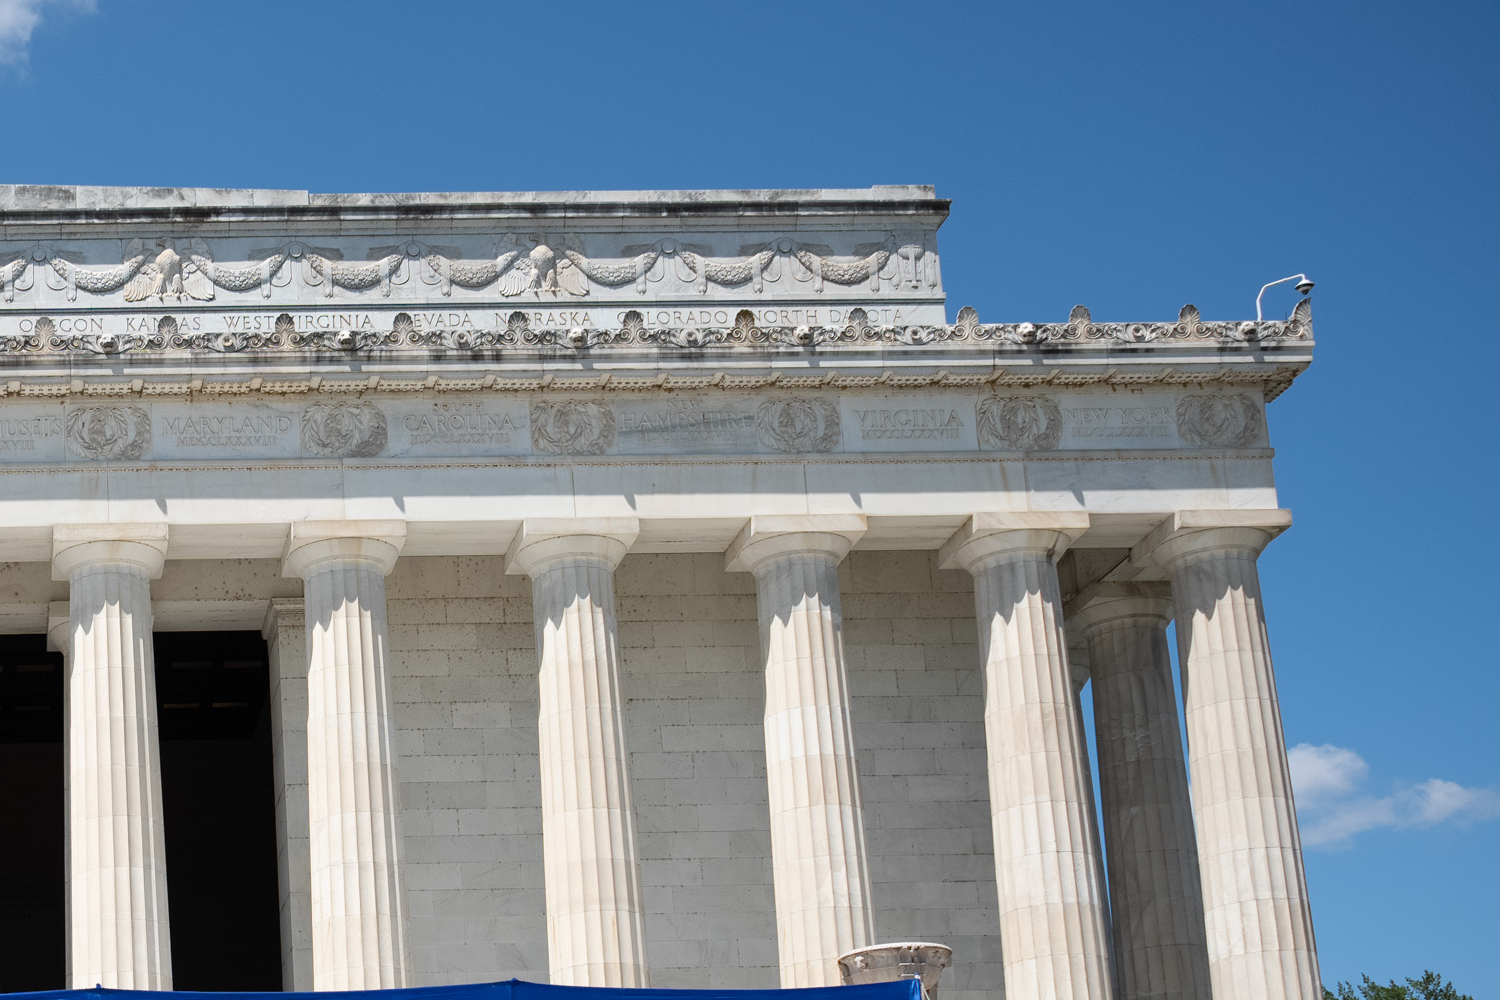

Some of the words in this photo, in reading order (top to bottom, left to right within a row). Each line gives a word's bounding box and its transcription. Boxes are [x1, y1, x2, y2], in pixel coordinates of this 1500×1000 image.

[223, 316, 275, 331] WEST
[291, 315, 376, 330] IRGINIA
[413, 313, 474, 328] EVADA
[495, 312, 594, 327] NBRASKA
[617, 310, 728, 325] CLORADO
[829, 309, 905, 324] DAOTA
[19, 318, 104, 332] OGON
[125, 317, 201, 332] KANAS
[432, 402, 484, 414] SOUTH
[666, 400, 704, 411] NEW
[402, 414, 517, 432] CAROLINA
[620, 411, 754, 431] HAMPSHIRE
[852, 408, 965, 428] VIRGINIA
[1062, 408, 1109, 425] NEW
[1117, 407, 1175, 424] YORK
[162, 416, 292, 435] MARYLAND
